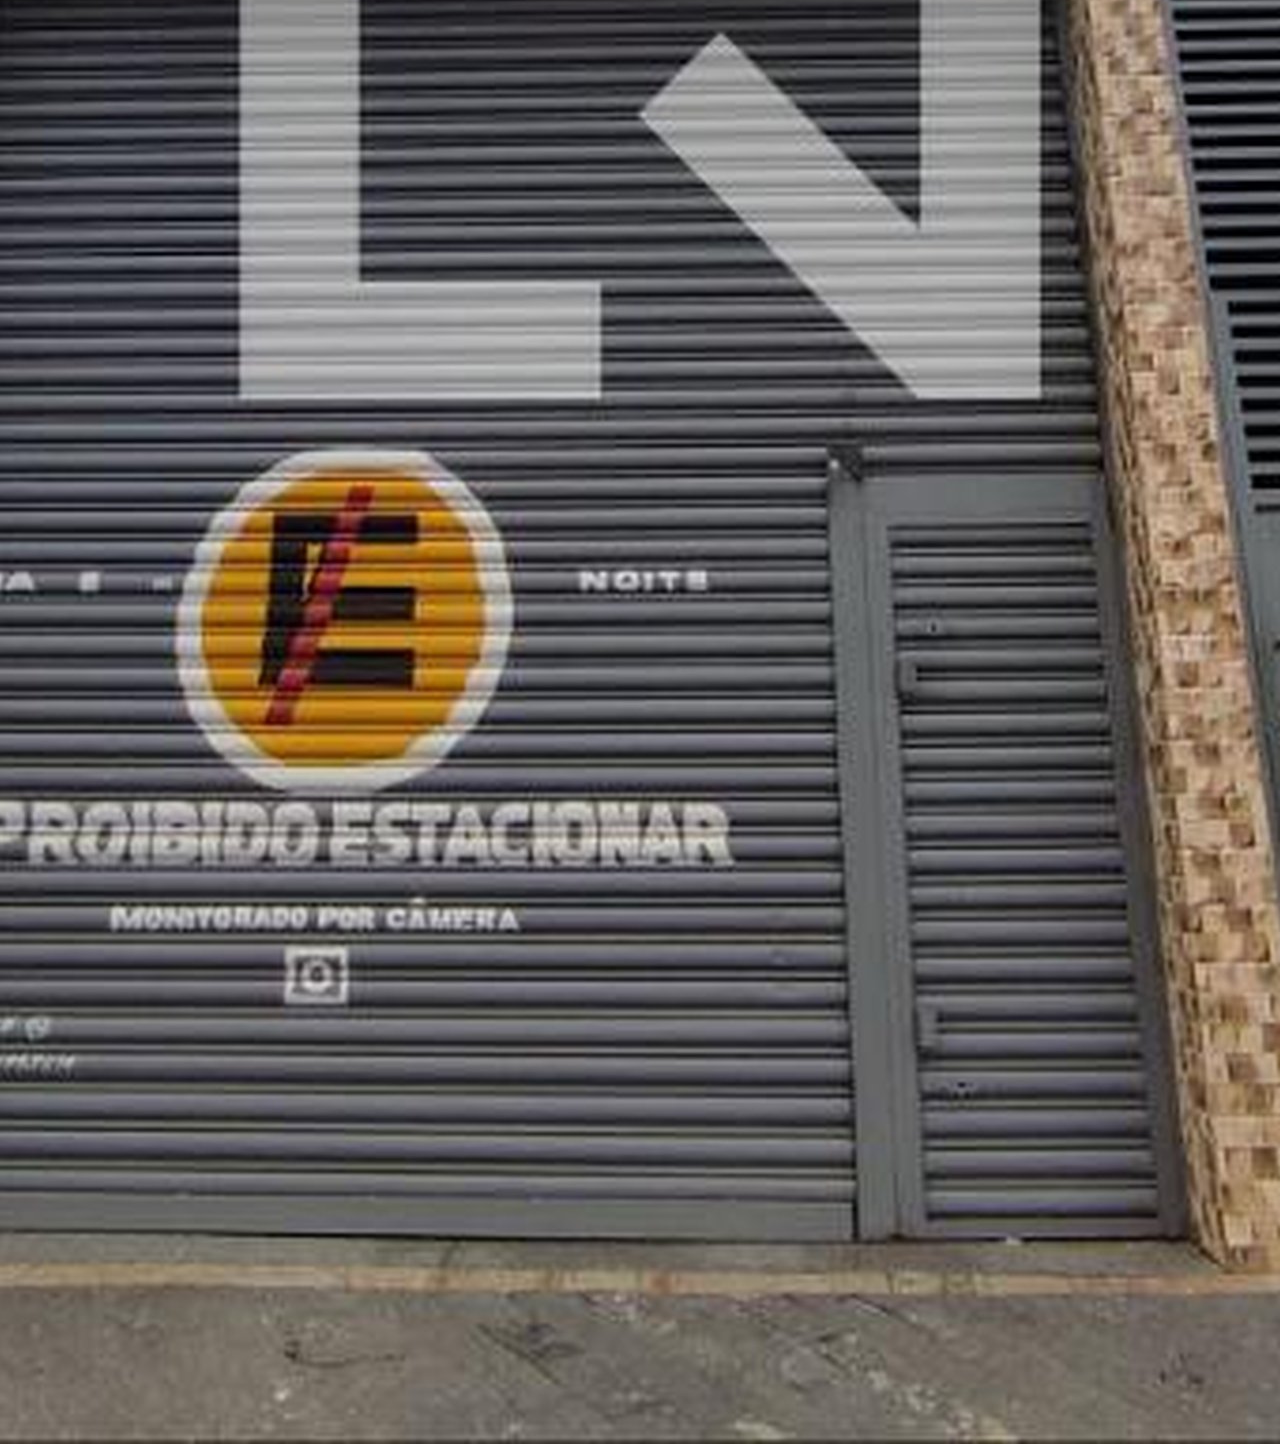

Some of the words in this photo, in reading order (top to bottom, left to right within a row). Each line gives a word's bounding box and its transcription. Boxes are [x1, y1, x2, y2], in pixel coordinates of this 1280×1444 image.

[579, 570, 708, 592] NOITE
[327, 799, 736, 868] ESTACIONAR
[109, 905, 309, 933] MONITORADO
[318, 905, 377, 932] POR
[385, 896, 521, 932] CÂMERA
